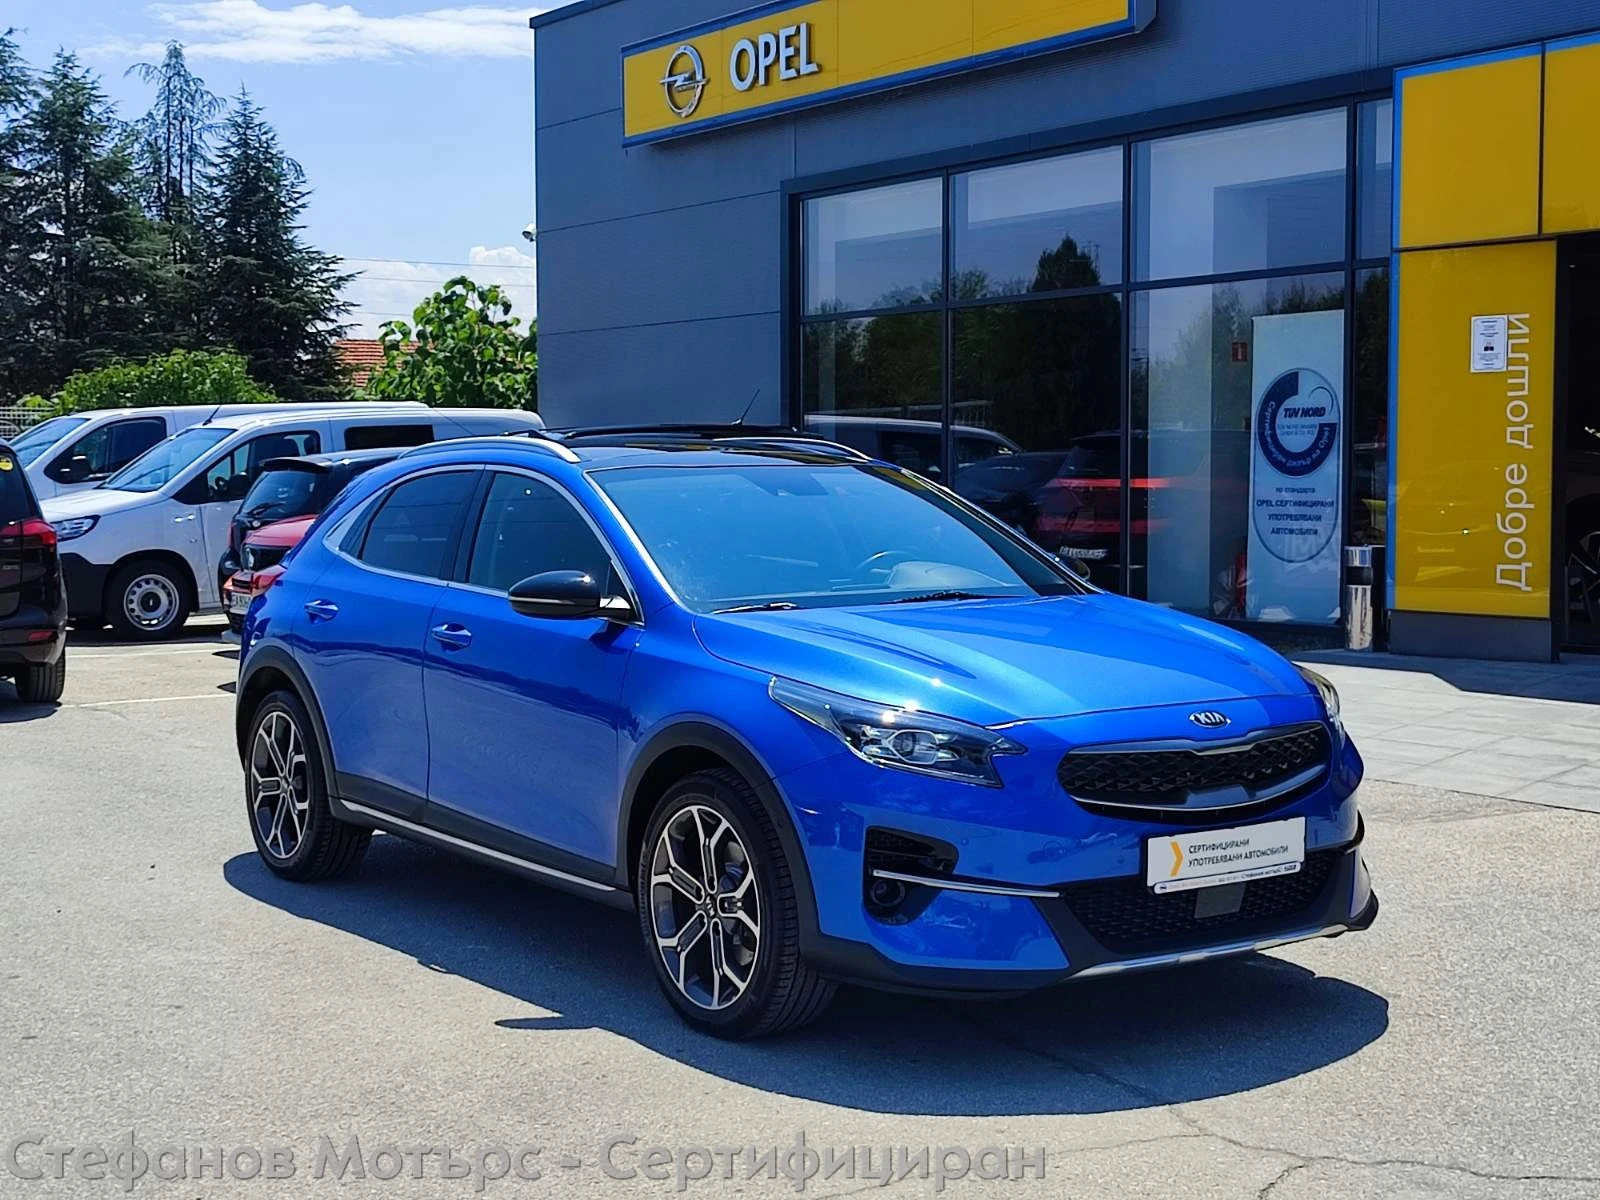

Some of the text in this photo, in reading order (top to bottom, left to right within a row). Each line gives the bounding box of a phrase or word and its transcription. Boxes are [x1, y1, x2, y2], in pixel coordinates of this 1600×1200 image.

[730, 22, 819, 91] OPEL
[1300, 406, 1326, 418] NORD
[1496, 313, 1535, 592] Добре дошли
[1188, 838, 1250, 854] СЕРТИФИЦИРАНИ
[1188, 844, 1289, 867] УПОТРЕБЯВАНИ АВТОМОБИЛИ
